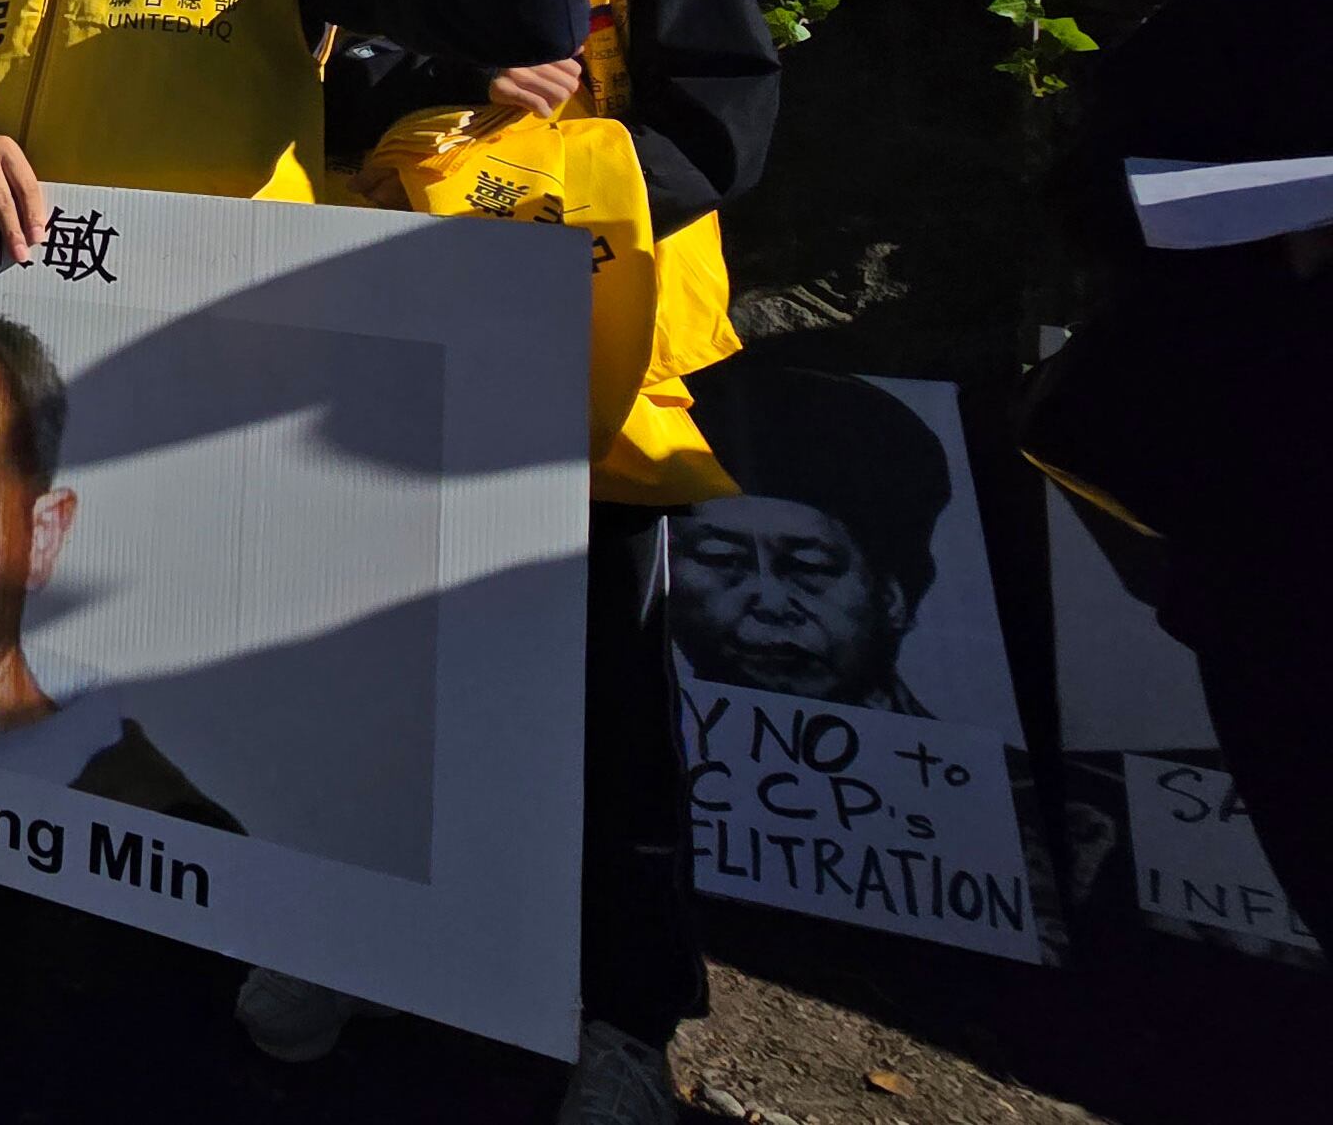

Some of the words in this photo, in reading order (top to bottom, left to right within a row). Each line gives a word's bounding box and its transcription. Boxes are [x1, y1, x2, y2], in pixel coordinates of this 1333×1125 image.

[108, 12, 191, 34] UNITED
[198, 18, 233, 43] HQ
[750, 706, 860, 774] NO
[894, 741, 971, 789] to
[88, 821, 211, 909] Min
[691, 818, 1025, 933] FLITRATION
